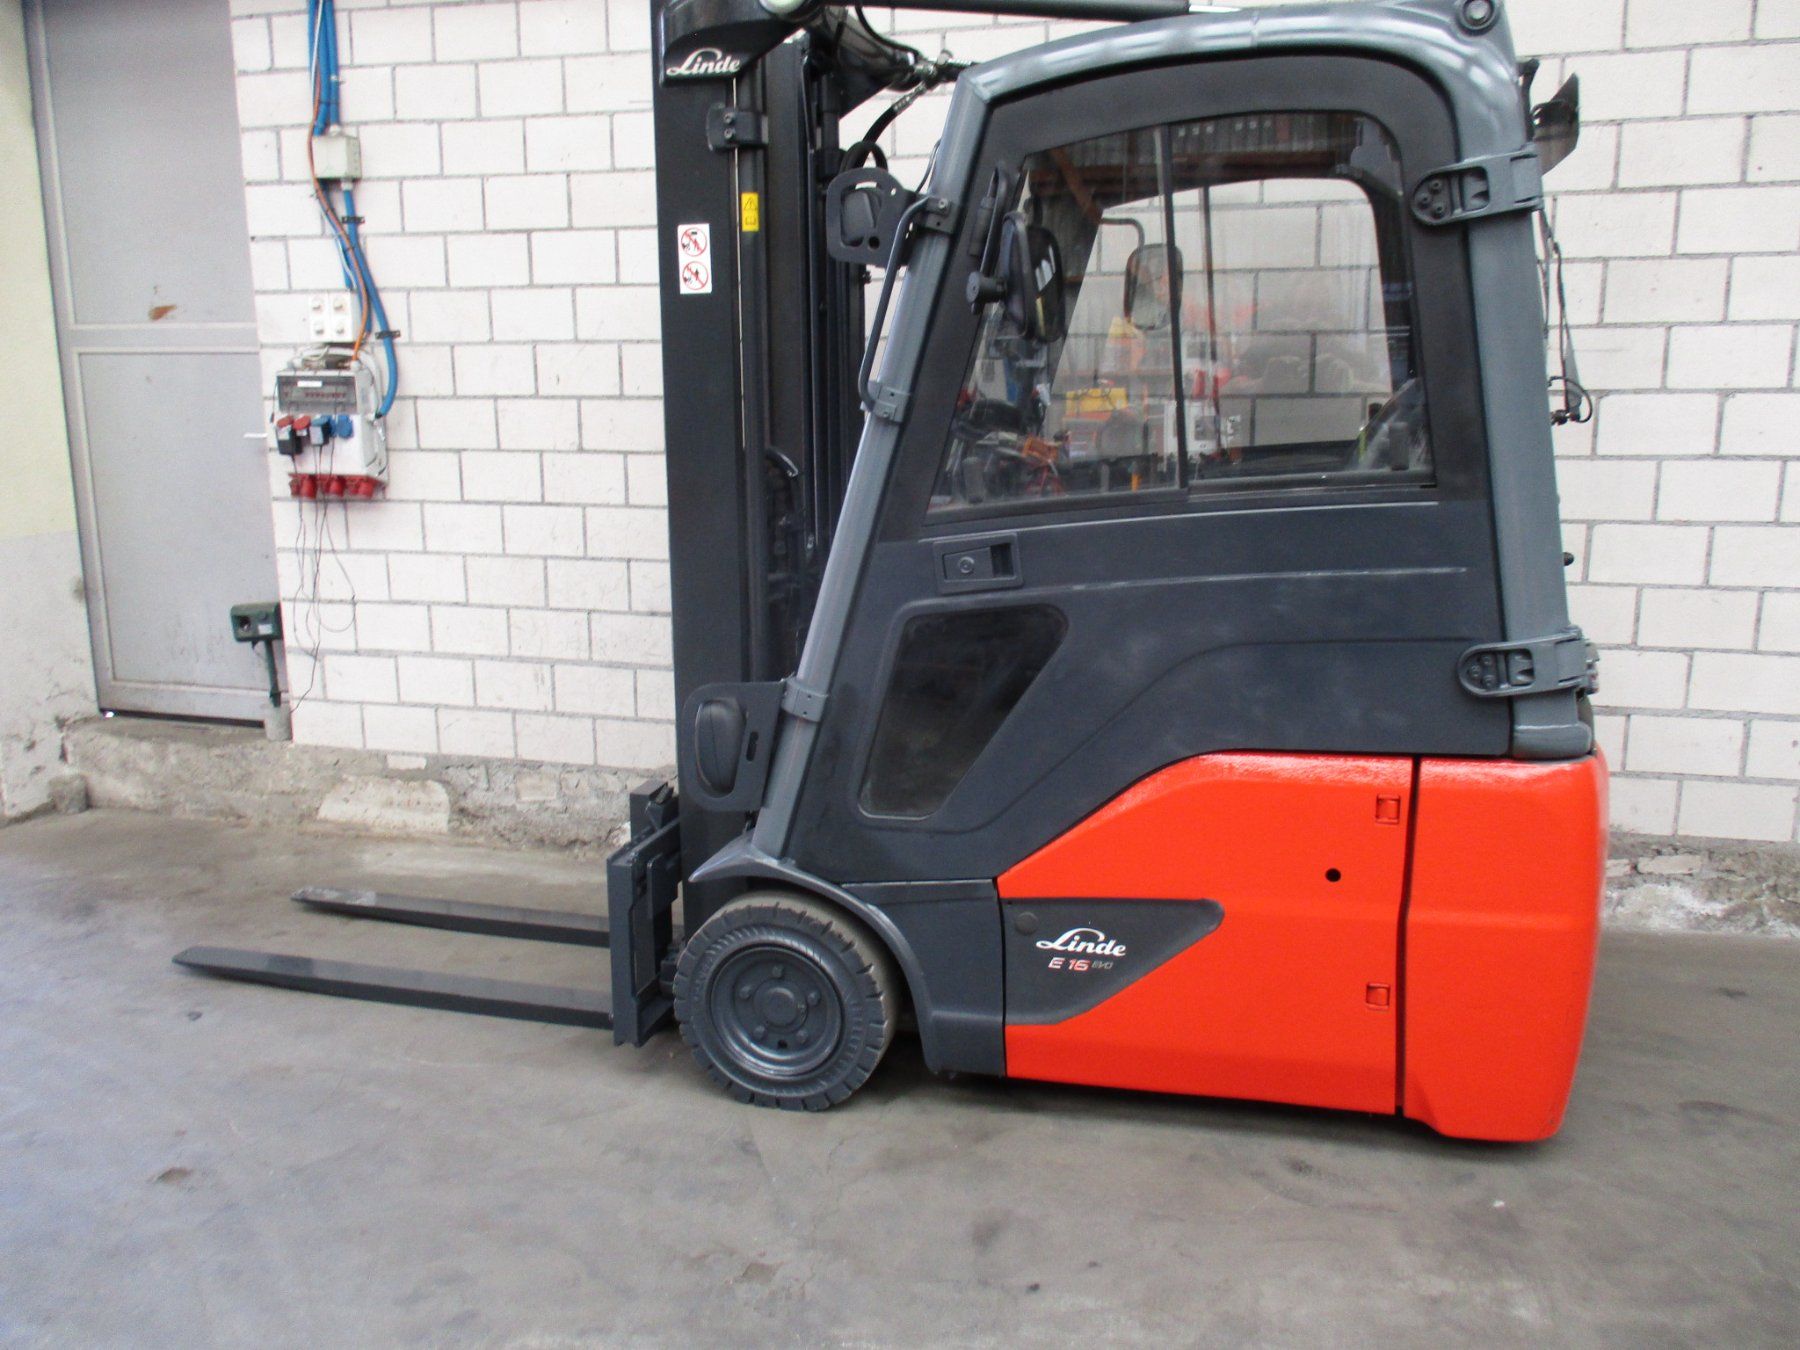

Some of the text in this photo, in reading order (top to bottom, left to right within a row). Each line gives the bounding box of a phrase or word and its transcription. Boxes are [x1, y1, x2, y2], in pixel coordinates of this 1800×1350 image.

[666, 47, 740, 76] Linde
[1036, 927, 1126, 956] Linde
[1048, 957, 1066, 969] E
[1068, 959, 1090, 971] 16
